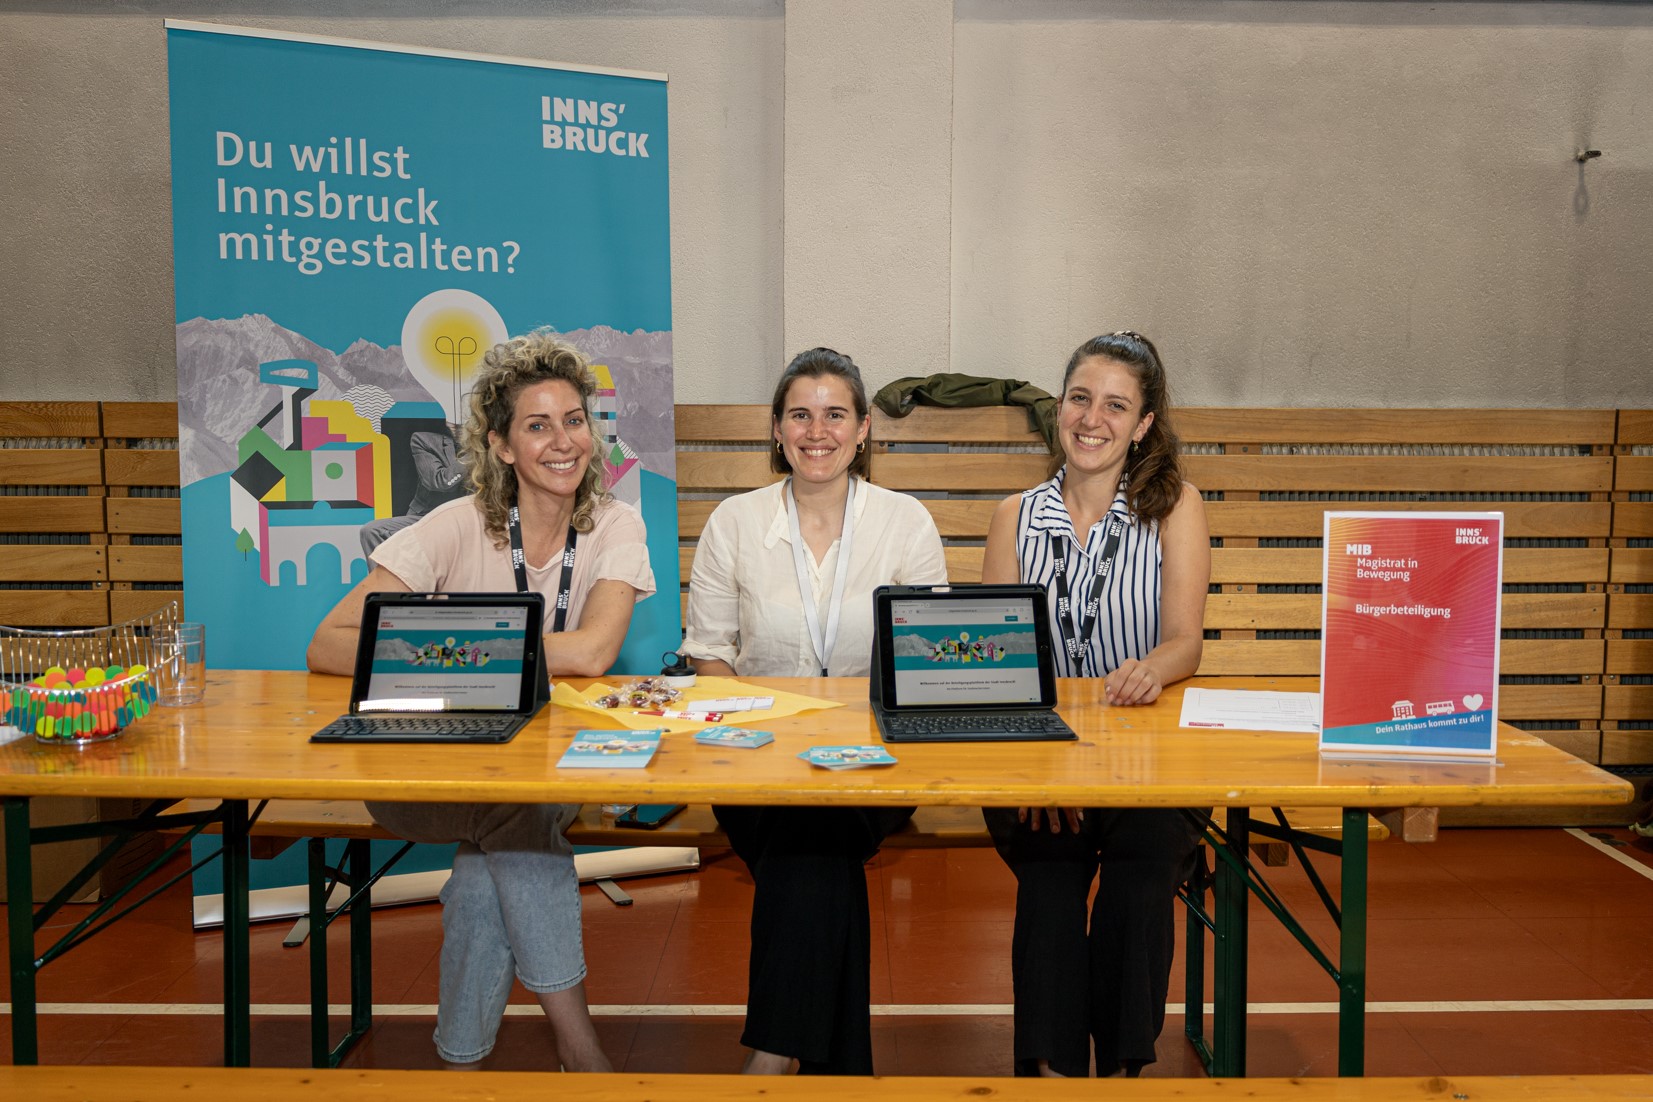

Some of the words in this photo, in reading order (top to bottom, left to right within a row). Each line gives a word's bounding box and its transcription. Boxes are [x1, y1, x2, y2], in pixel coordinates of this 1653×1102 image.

[542, 96, 625, 128] INNS'
[542, 123, 649, 158] BRUCK
[216, 131, 272, 169] Du
[289, 136, 411, 180] willst
[217, 178, 439, 226] Innsbruck
[218, 223, 520, 275] mitgestalten?
[1455, 528, 1482, 537] INNS'
[1455, 536, 1489, 545] BRUCK
[512, 549, 520, 570] BRUCK
[568, 547, 576, 568] BRUCK
[1346, 544, 1372, 556] MIB
[1102, 557, 1112, 577] BRUCK
[1357, 557, 1405, 570] Magistrat
[1408, 558, 1418, 569] in
[1356, 568, 1410, 582] Bewegung
[562, 589, 570, 609] BRUCK
[1058, 597, 1066, 618] BRUCK
[1090, 597, 1100, 618] BRUCK
[1355, 603, 1451, 619] Bürgerbeteiligung
[1375, 723, 1394, 734] Dein
[1394, 720, 1427, 732] Rathaus
[1428, 717, 1457, 728] kommt
[1458, 716, 1468, 725] zu
[1469, 714, 1484, 723] dir!
